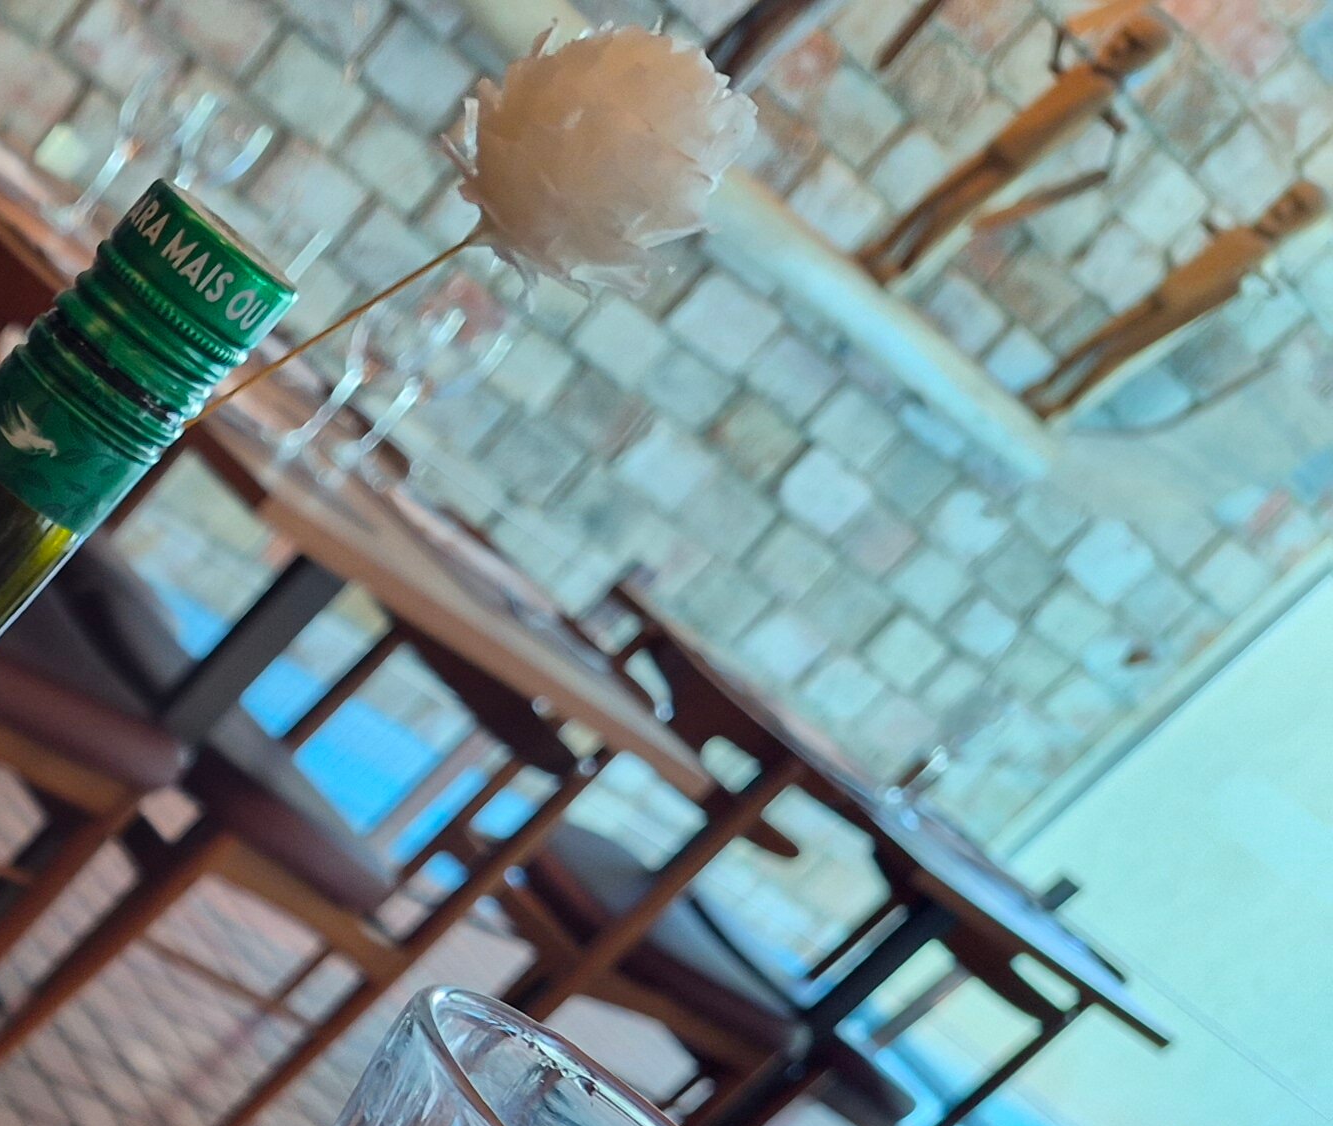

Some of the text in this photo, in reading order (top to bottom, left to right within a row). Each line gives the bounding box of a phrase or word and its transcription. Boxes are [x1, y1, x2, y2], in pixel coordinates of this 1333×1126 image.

[128, 194, 271, 331] ARA MAIS OU
